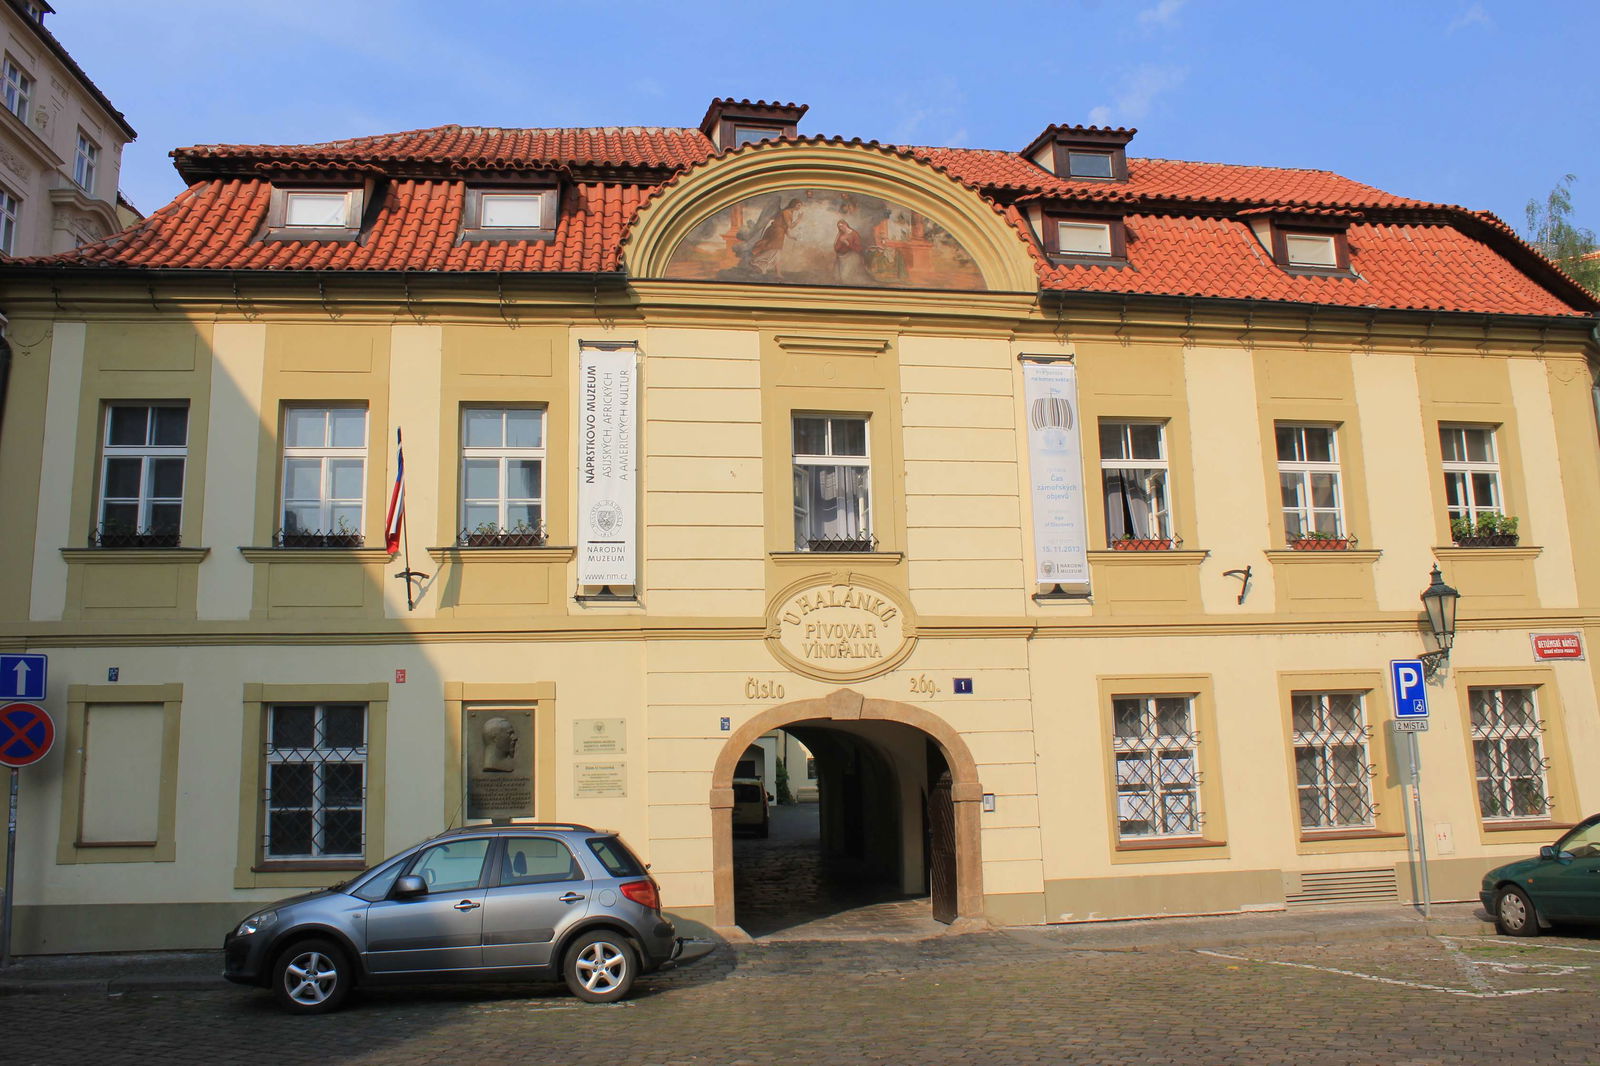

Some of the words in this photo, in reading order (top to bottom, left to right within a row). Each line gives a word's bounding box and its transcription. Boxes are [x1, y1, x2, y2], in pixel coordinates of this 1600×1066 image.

[586, 365, 596, 412] MUZEUM
[602, 372, 613, 424] AFRICKÝCH
[619, 370, 629, 406] KULTUR
[585, 414, 596, 484] NÁPRSTKOVO
[618, 409, 629, 472] AMERICKÝCH
[619, 473, 628, 481] A
[587, 545, 626, 553] NÁRODNÍ
[783, 610, 801, 626] U
[1398, 667, 1418, 700] P
